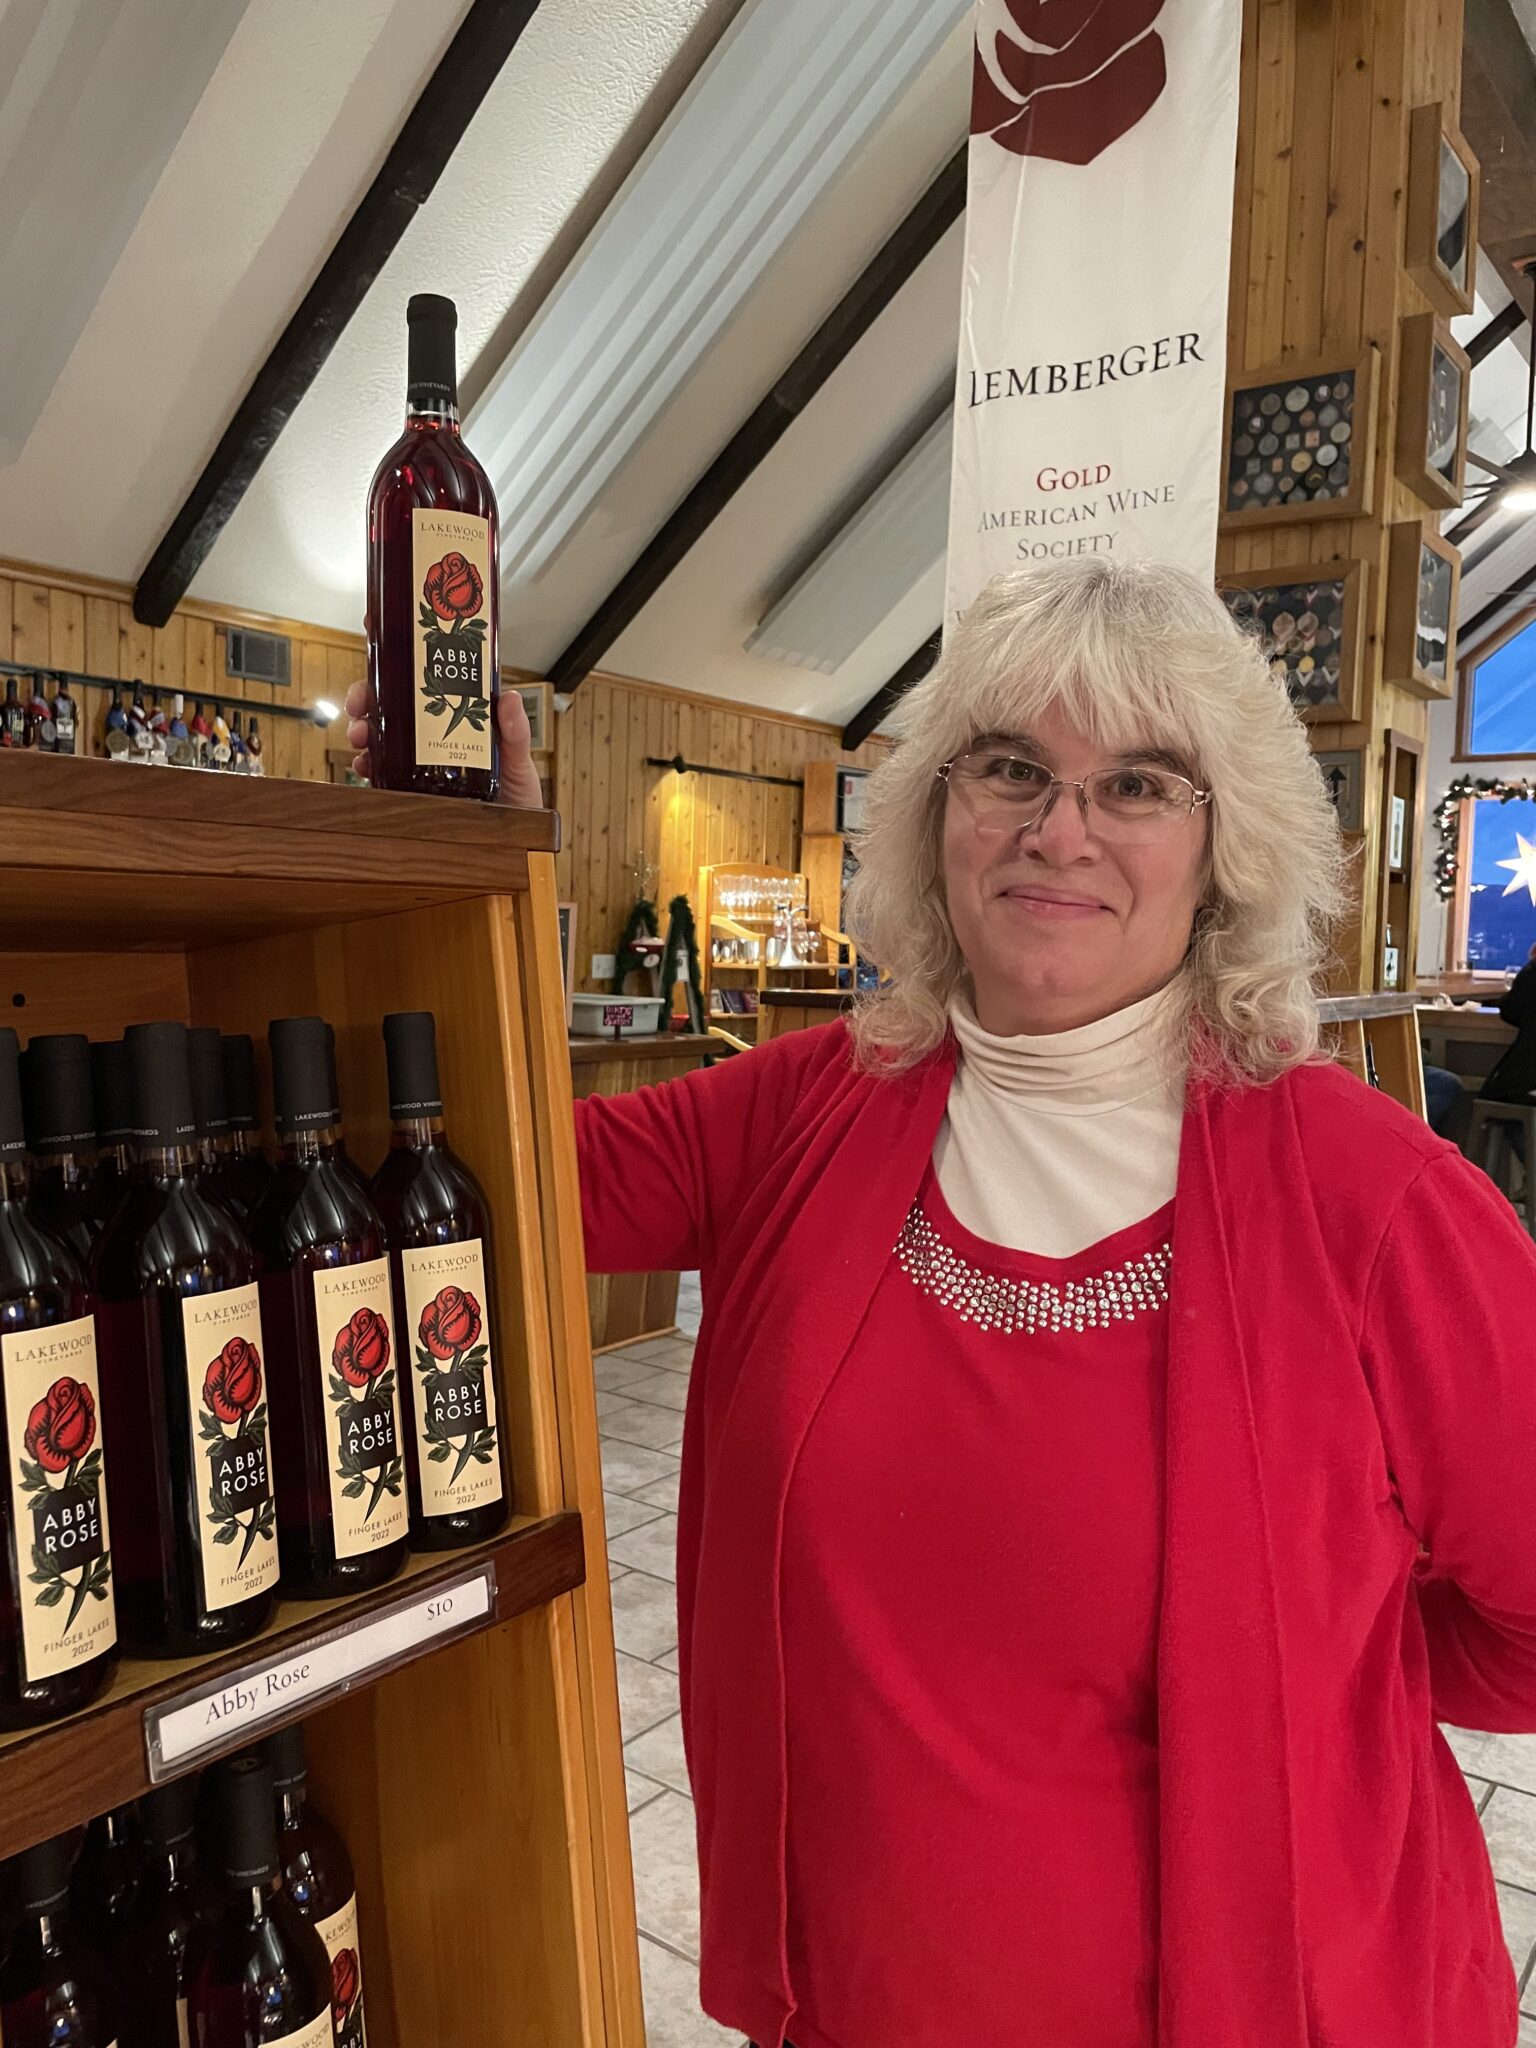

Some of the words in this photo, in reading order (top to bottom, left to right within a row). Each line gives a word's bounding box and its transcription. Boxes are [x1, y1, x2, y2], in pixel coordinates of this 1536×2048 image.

[968, 332, 1205, 408] LEMBERGER
[1037, 464, 1111, 492] GOLD
[977, 501, 1098, 533] AMERICAN
[1107, 485, 1175, 515] WINE
[421, 522, 485, 540] LAKEWOOD
[1016, 531, 1119, 560] SOCIETY
[433, 648, 478, 665] ABBY
[434, 664, 478, 681] ROSE
[428, 741, 459, 749] FINGER
[462, 743, 484, 752] LAKES
[449, 752, 467, 760] 2022
[411, 1253, 479, 1273] LAKEWOOD
[324, 1273, 386, 1294] LAKEWOOD
[194, 1299, 258, 1324] LAKEWOOD
[16, 1334, 92, 1362] LAKEWOOD
[433, 1382, 480, 1405] ABBY
[347, 1409, 391, 1437] ABBY
[435, 1399, 482, 1423] ROSE
[349, 1427, 393, 1455] ROSE
[219, 1446, 264, 1478] ABBY
[221, 1466, 266, 1497] ROSE
[434, 1485, 467, 1498] FINGER
[470, 1477, 493, 1492] LAKES
[456, 1493, 477, 1505] 2022
[42, 1497, 97, 1533] ABBY
[348, 1521, 381, 1537] FINGER
[384, 1511, 403, 1527] LAKES
[45, 1518, 99, 1554] ROSE
[370, 1528, 390, 1542] 2022
[220, 1568, 254, 1587] FINGER
[257, 1556, 275, 1573] LAKES
[243, 1575, 264, 1591] 2022
[43, 1630, 83, 1653] FINGER
[87, 1617, 110, 1637] LAKES
[72, 1640, 94, 1658] 2022
[204, 1685, 258, 1725] Abby
[265, 1663, 311, 1697] Rose
[426, 1597, 454, 1621] $10
